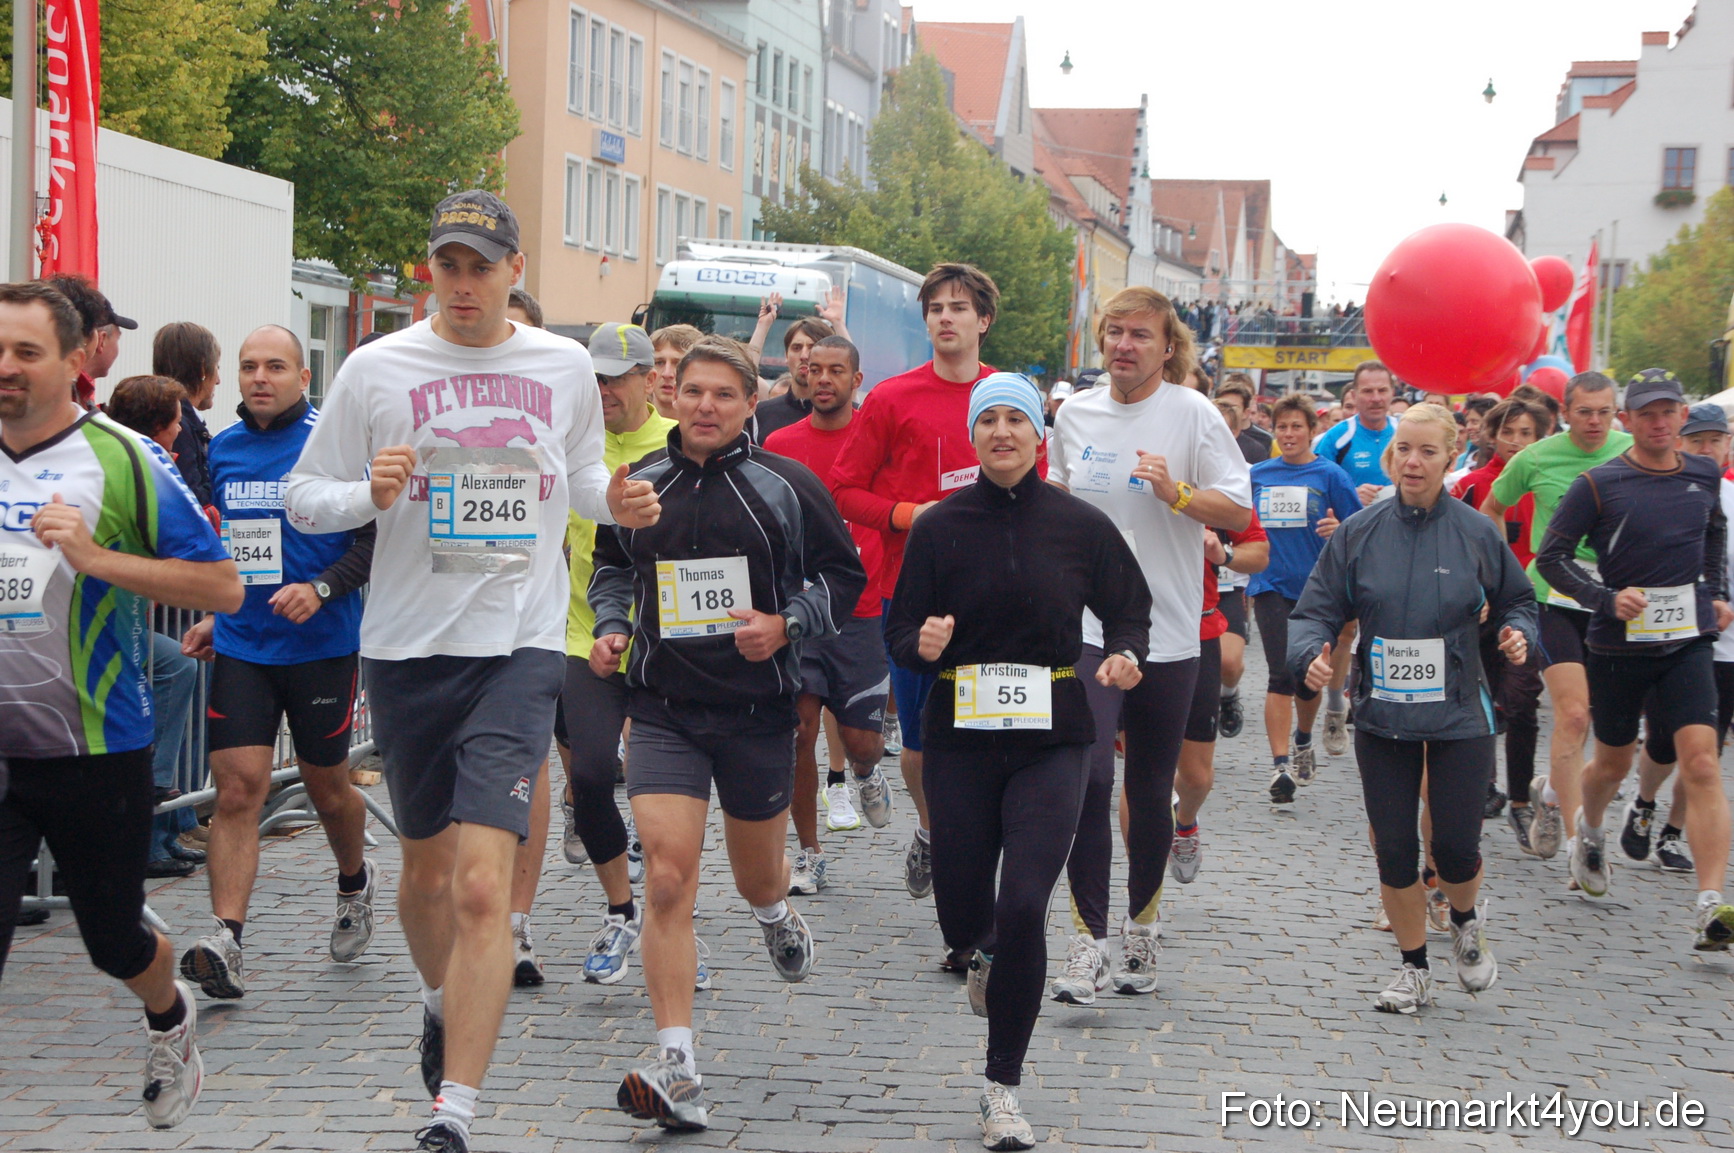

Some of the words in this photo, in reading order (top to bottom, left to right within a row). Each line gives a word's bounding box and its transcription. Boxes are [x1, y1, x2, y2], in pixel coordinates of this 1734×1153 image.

[697, 268, 777, 286] BOCK
[1275, 352, 1330, 364] START
[450, 373, 553, 431] VERNON
[461, 475, 526, 490] Alexander
[437, 498, 443, 510] B
[462, 500, 527, 523] 2846
[1272, 502, 1301, 513] 3232
[232, 528, 272, 539] Alexander
[234, 546, 273, 562] 2544
[678, 567, 725, 582] Thomas
[691, 588, 735, 611] 188
[1653, 607, 1685, 623] 273
[1387, 646, 1420, 658] Marika
[980, 662, 1028, 678] Kristina
[1389, 663, 1436, 681] 2289
[959, 686, 965, 697] B
[997, 685, 1028, 705] 55
